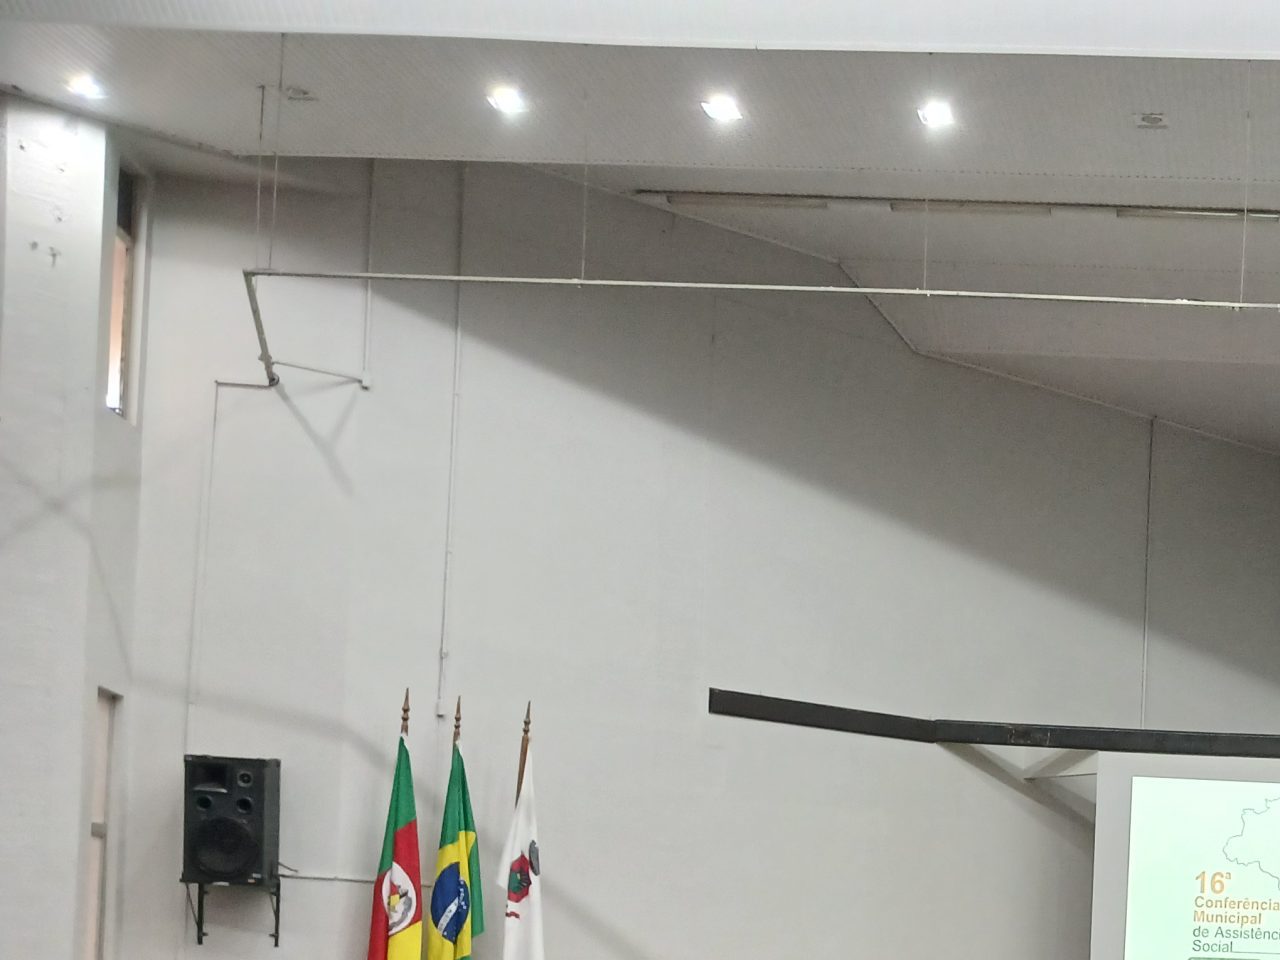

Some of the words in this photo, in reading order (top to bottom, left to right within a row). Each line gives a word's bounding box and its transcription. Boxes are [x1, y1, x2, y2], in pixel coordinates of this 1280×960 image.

[1195, 870, 1232, 895] 16ª
[1194, 895, 1280, 912] Conferência
[1193, 910, 1262, 929] Municipal
[1192, 925, 1210, 938] de
[1191, 939, 1233, 953] Social
